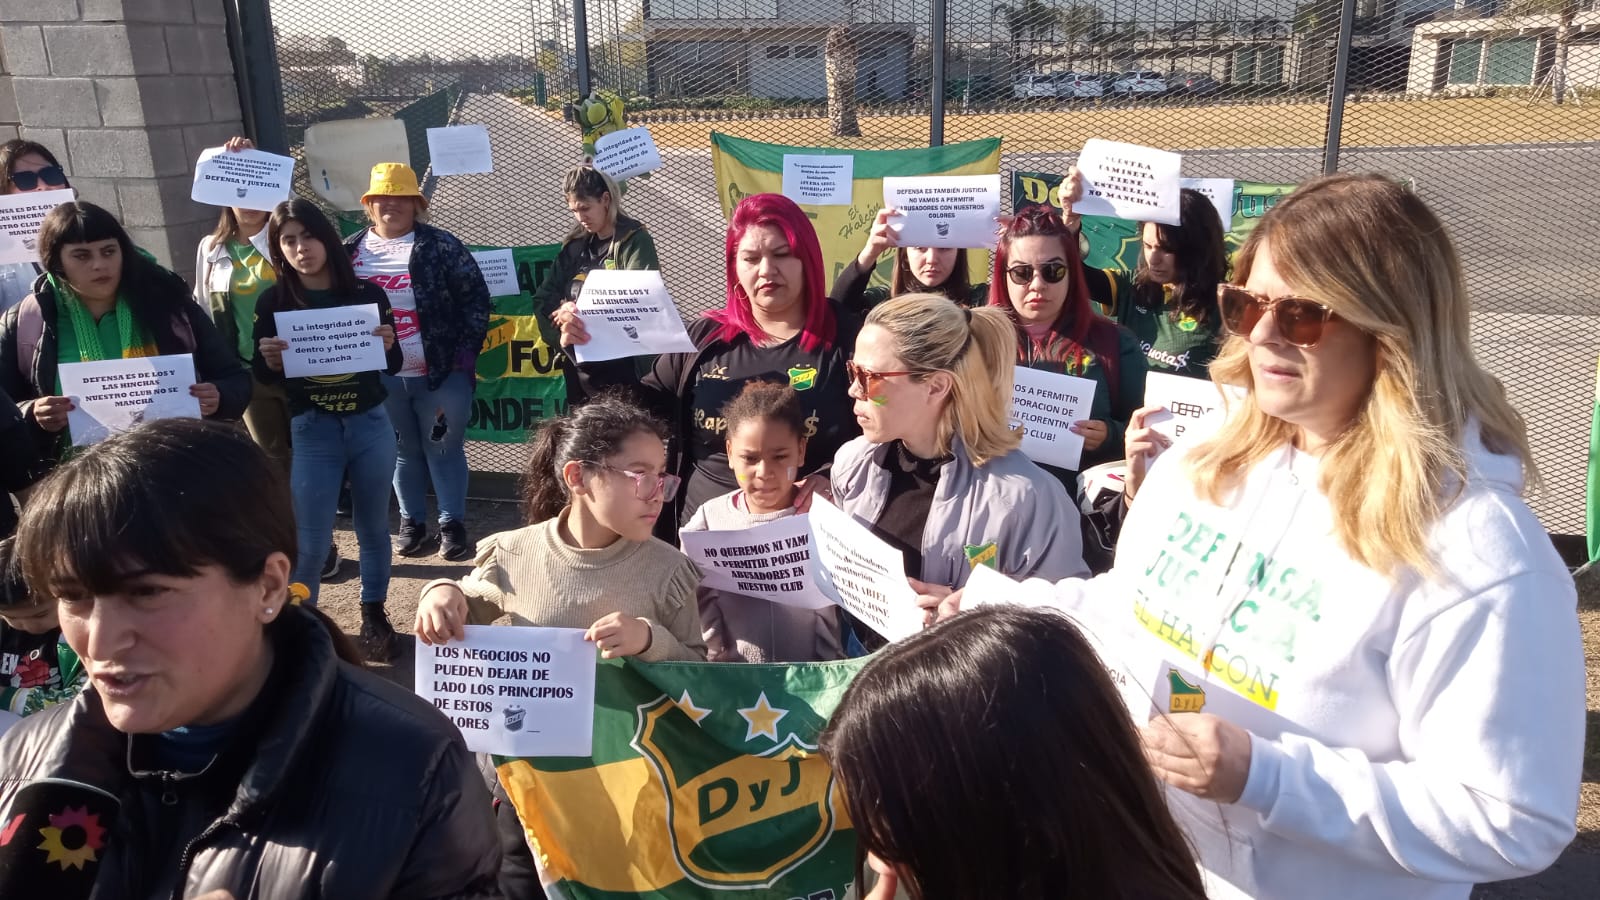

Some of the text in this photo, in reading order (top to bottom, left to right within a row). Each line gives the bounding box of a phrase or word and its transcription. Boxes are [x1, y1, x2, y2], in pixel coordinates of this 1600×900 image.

[603, 137, 632, 152] integridad
[205, 174, 240, 184] DEFENSA
[307, 320, 352, 331] integridad
[328, 331, 358, 341] equipo
[334, 342, 357, 351] fuera
[319, 354, 352, 364] cancha
[82, 374, 124, 384] DEFENSA
[120, 380, 160, 389] HINCHAS
[85, 392, 127, 401] NUESTRO
[114, 398, 154, 407] MANCHA
[310, 391, 358, 402] Rápido
[1037, 389, 1079, 404] PERMITIR
[1012, 397, 1074, 417] PORACION DE
[1021, 412, 1069, 430] FLORENTIN
[1030, 430, 1056, 442] CLUB!
[704, 548, 717, 558] NO
[720, 542, 770, 558] QUEREMOS
[773, 541, 782, 552] NI
[722, 559, 769, 569] PERMITIR
[1167, 511, 1322, 622] DEFNSA
[732, 566, 805, 581] ABUSADORES EN
[738, 580, 804, 592] NUESTRO CLUB
[435, 646, 551, 663] LOS NEGOCIOS NO
[1157, 610, 1279, 702] HACON
[434, 663, 550, 681] PUEDEN DEJAR DE
[434, 681, 574, 699] LADO LOS PRINCIPIOS
[433, 698, 493, 713] DE ESTOS
[697, 756, 802, 826] D y J
